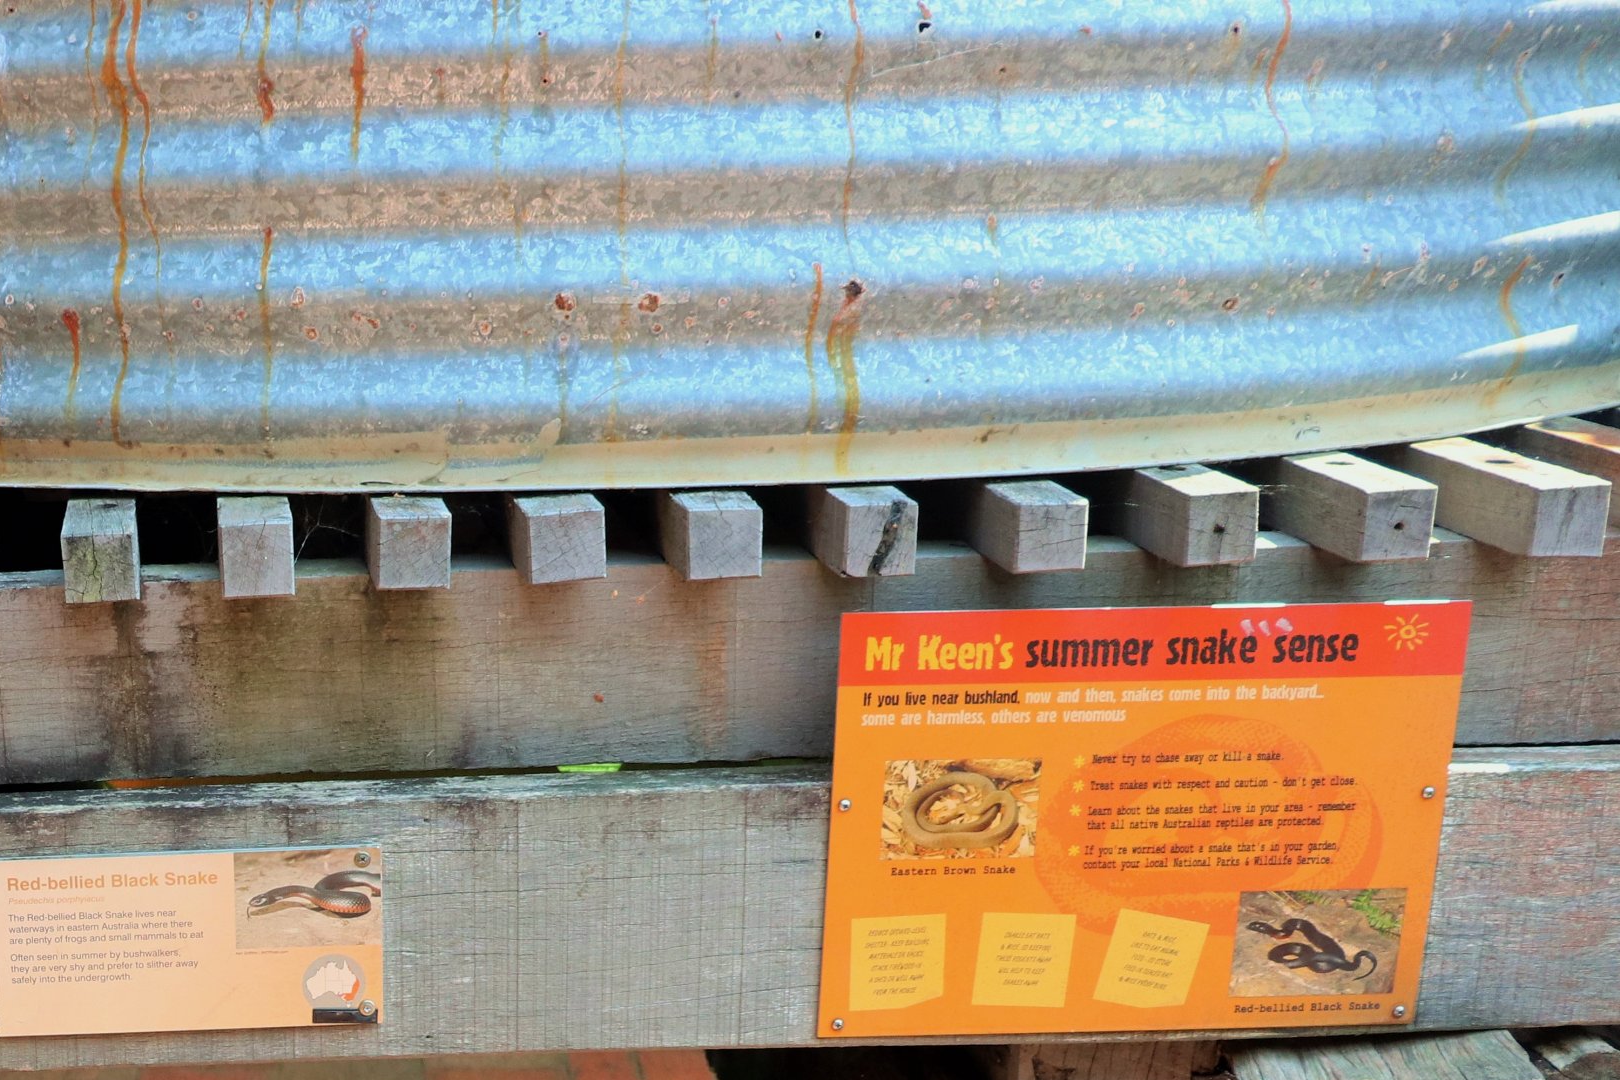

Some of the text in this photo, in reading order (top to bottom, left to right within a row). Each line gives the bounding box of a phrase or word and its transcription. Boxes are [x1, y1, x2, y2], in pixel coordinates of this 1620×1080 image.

[866, 629, 1359, 670] Mr Keen's summer snake sense
[863, 693, 872, 706] If
[877, 694, 899, 708] you
[905, 692, 926, 706] live
[932, 694, 959, 705] near
[1025, 692, 1052, 704] now
[1056, 689, 1080, 703] and
[1121, 688, 1164, 702] snakes
[1168, 689, 1202, 701] come
[1206, 687, 1231, 700] into
[1236, 686, 1257, 700] the
[861, 714, 896, 726] some
[901, 713, 922, 725] are
[991, 709, 1031, 724] others
[1036, 711, 1058, 723] are
[1063, 710, 1126, 723] venomous
[1092, 755, 1118, 764] Never
[1122, 755, 1137, 766] try
[1141, 755, 1151, 763] to
[1155, 753, 1180, 763] chase
[1184, 754, 1204, 764] away
[1208, 754, 1219, 762] or
[1222, 752, 1242, 762] kill
[1247, 753, 1252, 761] a
[1091, 781, 1114, 790] Treat
[1119, 780, 1148, 790] snakes
[1152, 779, 1172, 789] with
[1177, 780, 1211, 791] respect
[1215, 778, 1230, 788] and
[1234, 778, 1268, 788] caution
[1311, 777, 1326, 789] get
[1087, 806, 1112, 816] Learn
[1117, 806, 1141, 815] about
[1146, 805, 1160, 815] the
[1164, 805, 1193, 815] snakes
[1199, 804, 1217, 814] that
[1222, 804, 1241, 813] live
[1246, 805, 1255, 813] in
[1259, 804, 1280, 815] your
[1284, 804, 1303, 812] area
[1317, 802, 1356, 812] remember
[1087, 820, 1106, 830] that
[1110, 819, 1124, 830] all
[1129, 820, 1159, 829] native
[1162, 818, 1211, 829] Australian
[1215, 817, 1254, 829] reptiles
[1258, 819, 1273, 827] are
[1084, 846, 1094, 855] If
[1132, 844, 1166, 854] worried
[1170, 844, 1194, 854] about
[1198, 845, 1204, 853] a
[1208, 843, 1232, 853] snake
[1269, 844, 1280, 852] in
[1283, 843, 1304, 854] your
[1083, 860, 1117, 870] contact
[1120, 860, 1140, 870] your
[1144, 858, 1168, 868] local
[1173, 857, 1211, 868] National
[1216, 857, 1240, 867] Parks
[1254, 856, 1292, 866] Wildlife
[891, 865, 1016, 876] Eastern Brown Snake
[7, 871, 218, 891] Red-bellied Black Snake
[7, 914, 25, 922] The
[27, 912, 76, 922] Red-bellied
[79, 911, 103, 920] Black
[105, 910, 133, 919] Snake
[135, 910, 155, 918] lives
[8, 920, 193, 934] waterways in eastern Australia where there
[26, 936, 52, 946] plenty
[54, 935, 63, 943] of
[65, 935, 87, 944] frogs
[89, 934, 106, 942] and
[108, 933, 131, 941] small
[134, 931, 177, 940] mammals
[190, 931, 203, 939] eat
[10, 953, 34, 962] Often
[37, 952, 58, 961] seen
[110, 951, 121, 961] by
[10, 965, 30, 975] they
[49, 965, 67, 973] very
[69, 963, 85, 973] shy
[87, 962, 104, 971] and
[107, 961, 133, 972] prefer
[146, 960, 173, 968] slither
[175, 961, 198, 969] away
[12, 976, 37, 985] safely
[58, 975, 72, 983] the
[1234, 1001, 1380, 1013] Red-bellied Black Snake
